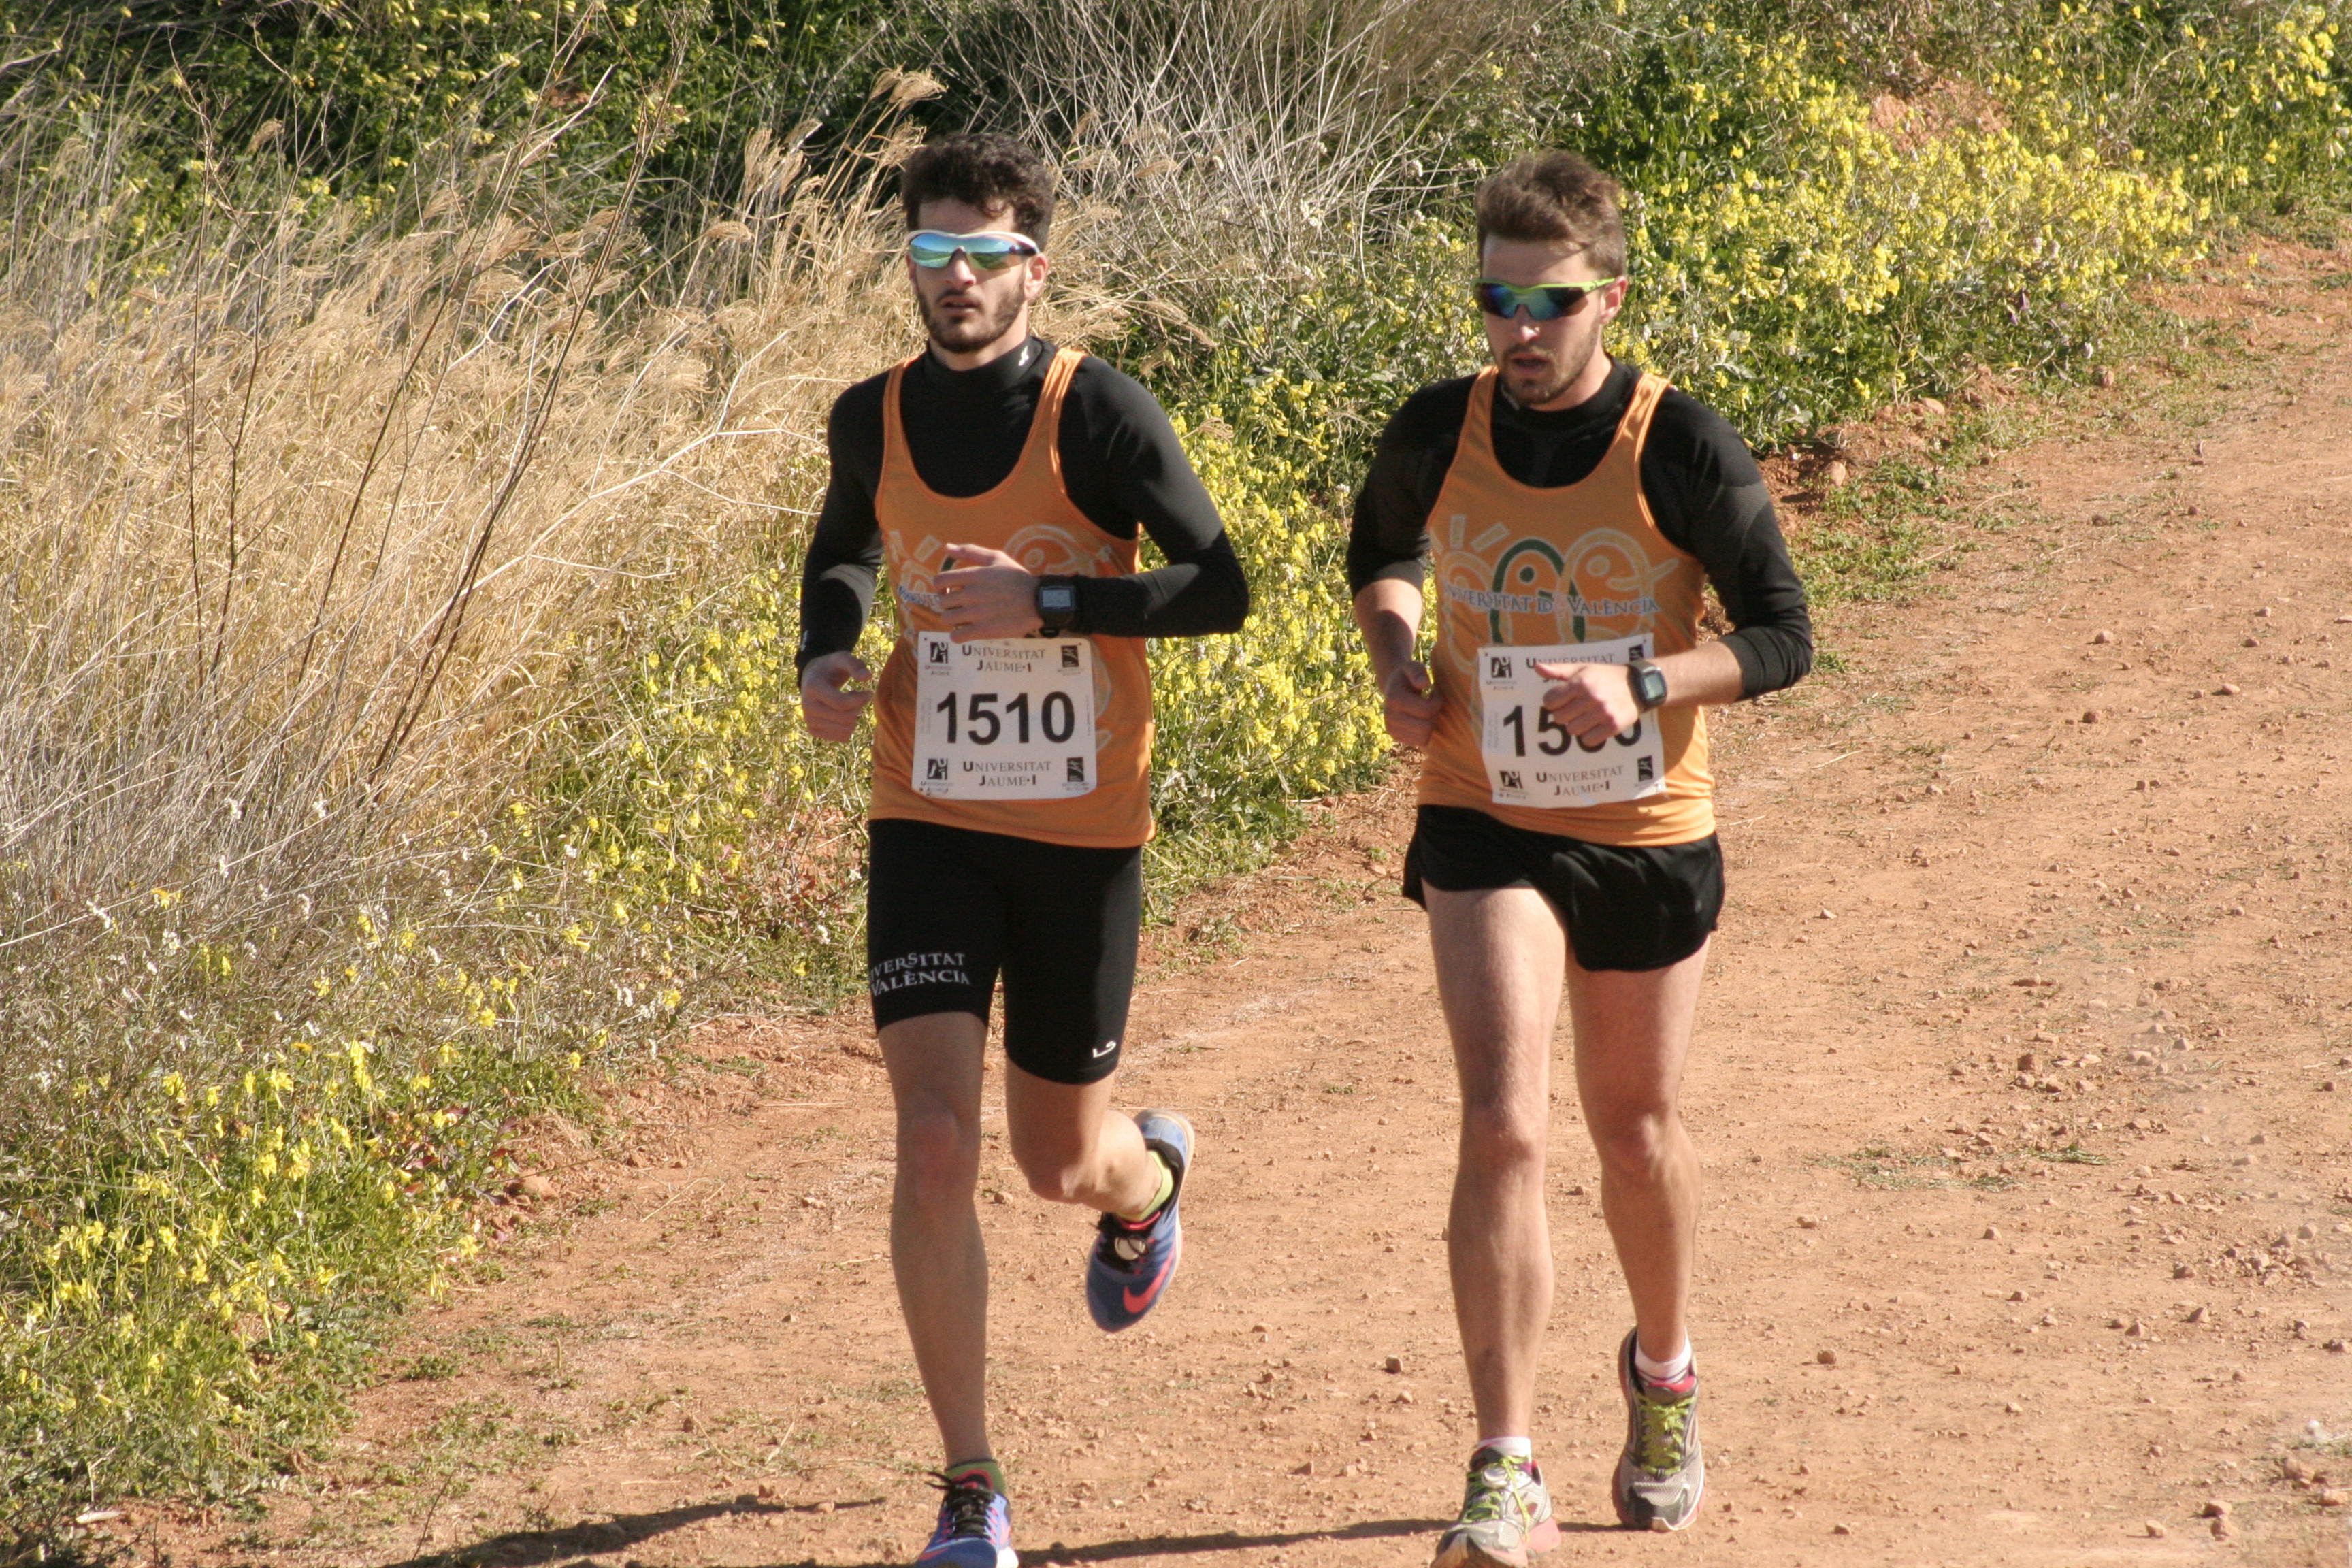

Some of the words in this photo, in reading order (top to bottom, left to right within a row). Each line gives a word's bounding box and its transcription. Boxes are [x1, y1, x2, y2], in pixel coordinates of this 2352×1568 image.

[962, 644, 1047, 659] UNIVERSITAT
[936, 691, 1075, 745] 1510
[962, 760, 1051, 772] UNIVERSITAT
[1535, 764, 1624, 783] UNIVERSITAT
